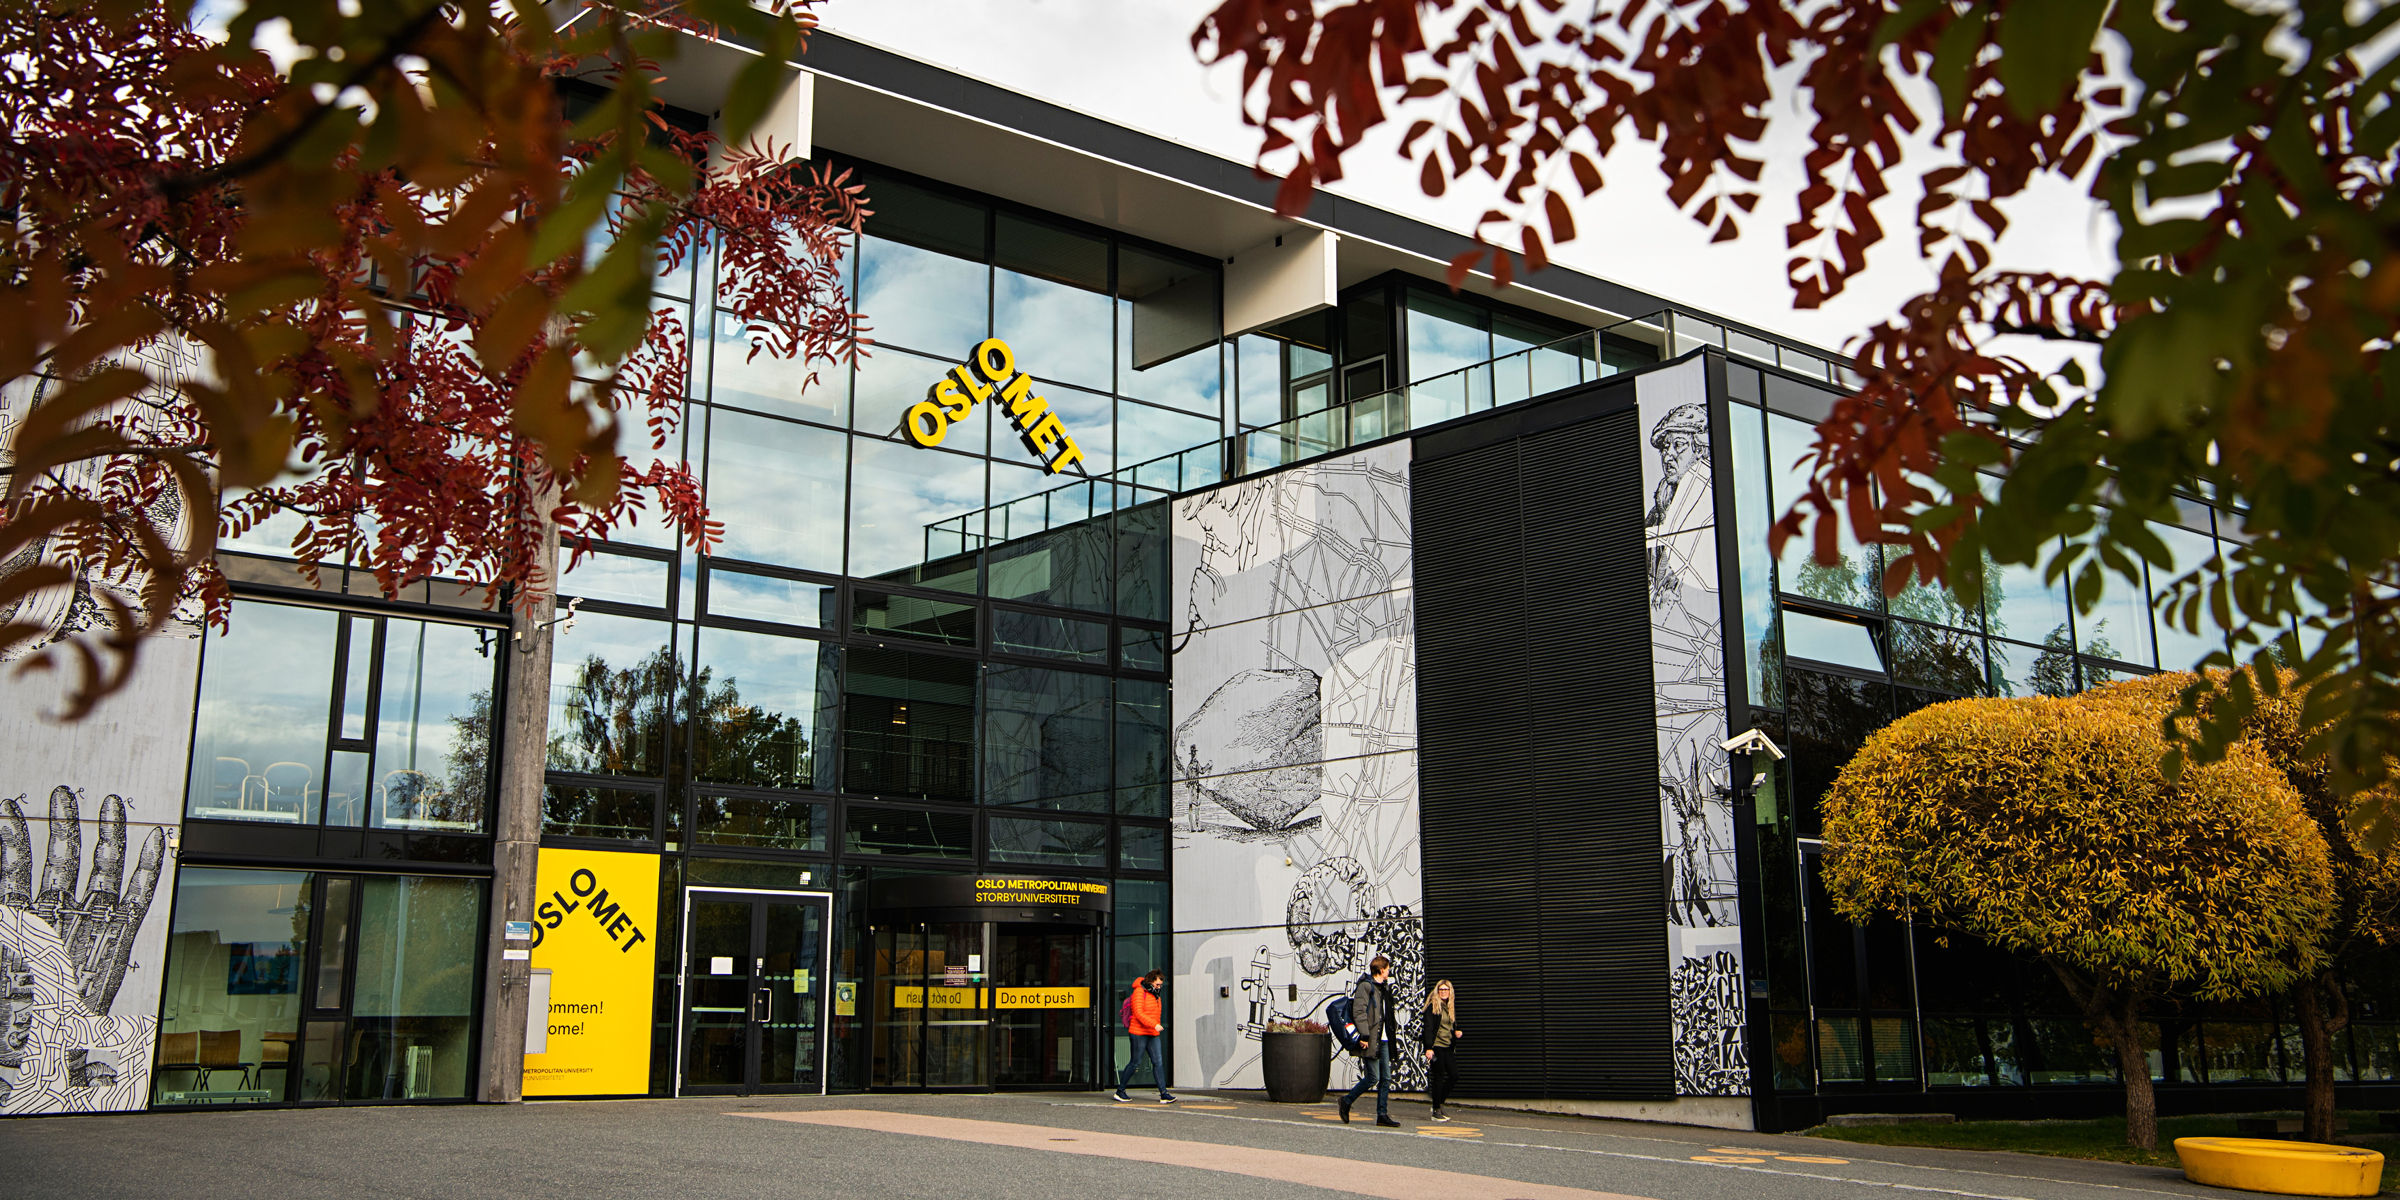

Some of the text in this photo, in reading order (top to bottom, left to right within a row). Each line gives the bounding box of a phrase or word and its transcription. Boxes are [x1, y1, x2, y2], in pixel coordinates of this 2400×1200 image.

[908, 338, 1084, 474] OSLOMET
[975, 879, 1006, 889] OSLO
[1007, 880, 1078, 891] METROPOLITAN
[975, 892, 1081, 905] STORBYUNIVERSITETET
[1001, 992, 1075, 1007] Do not push
[548, 1022, 584, 1035] ome!
